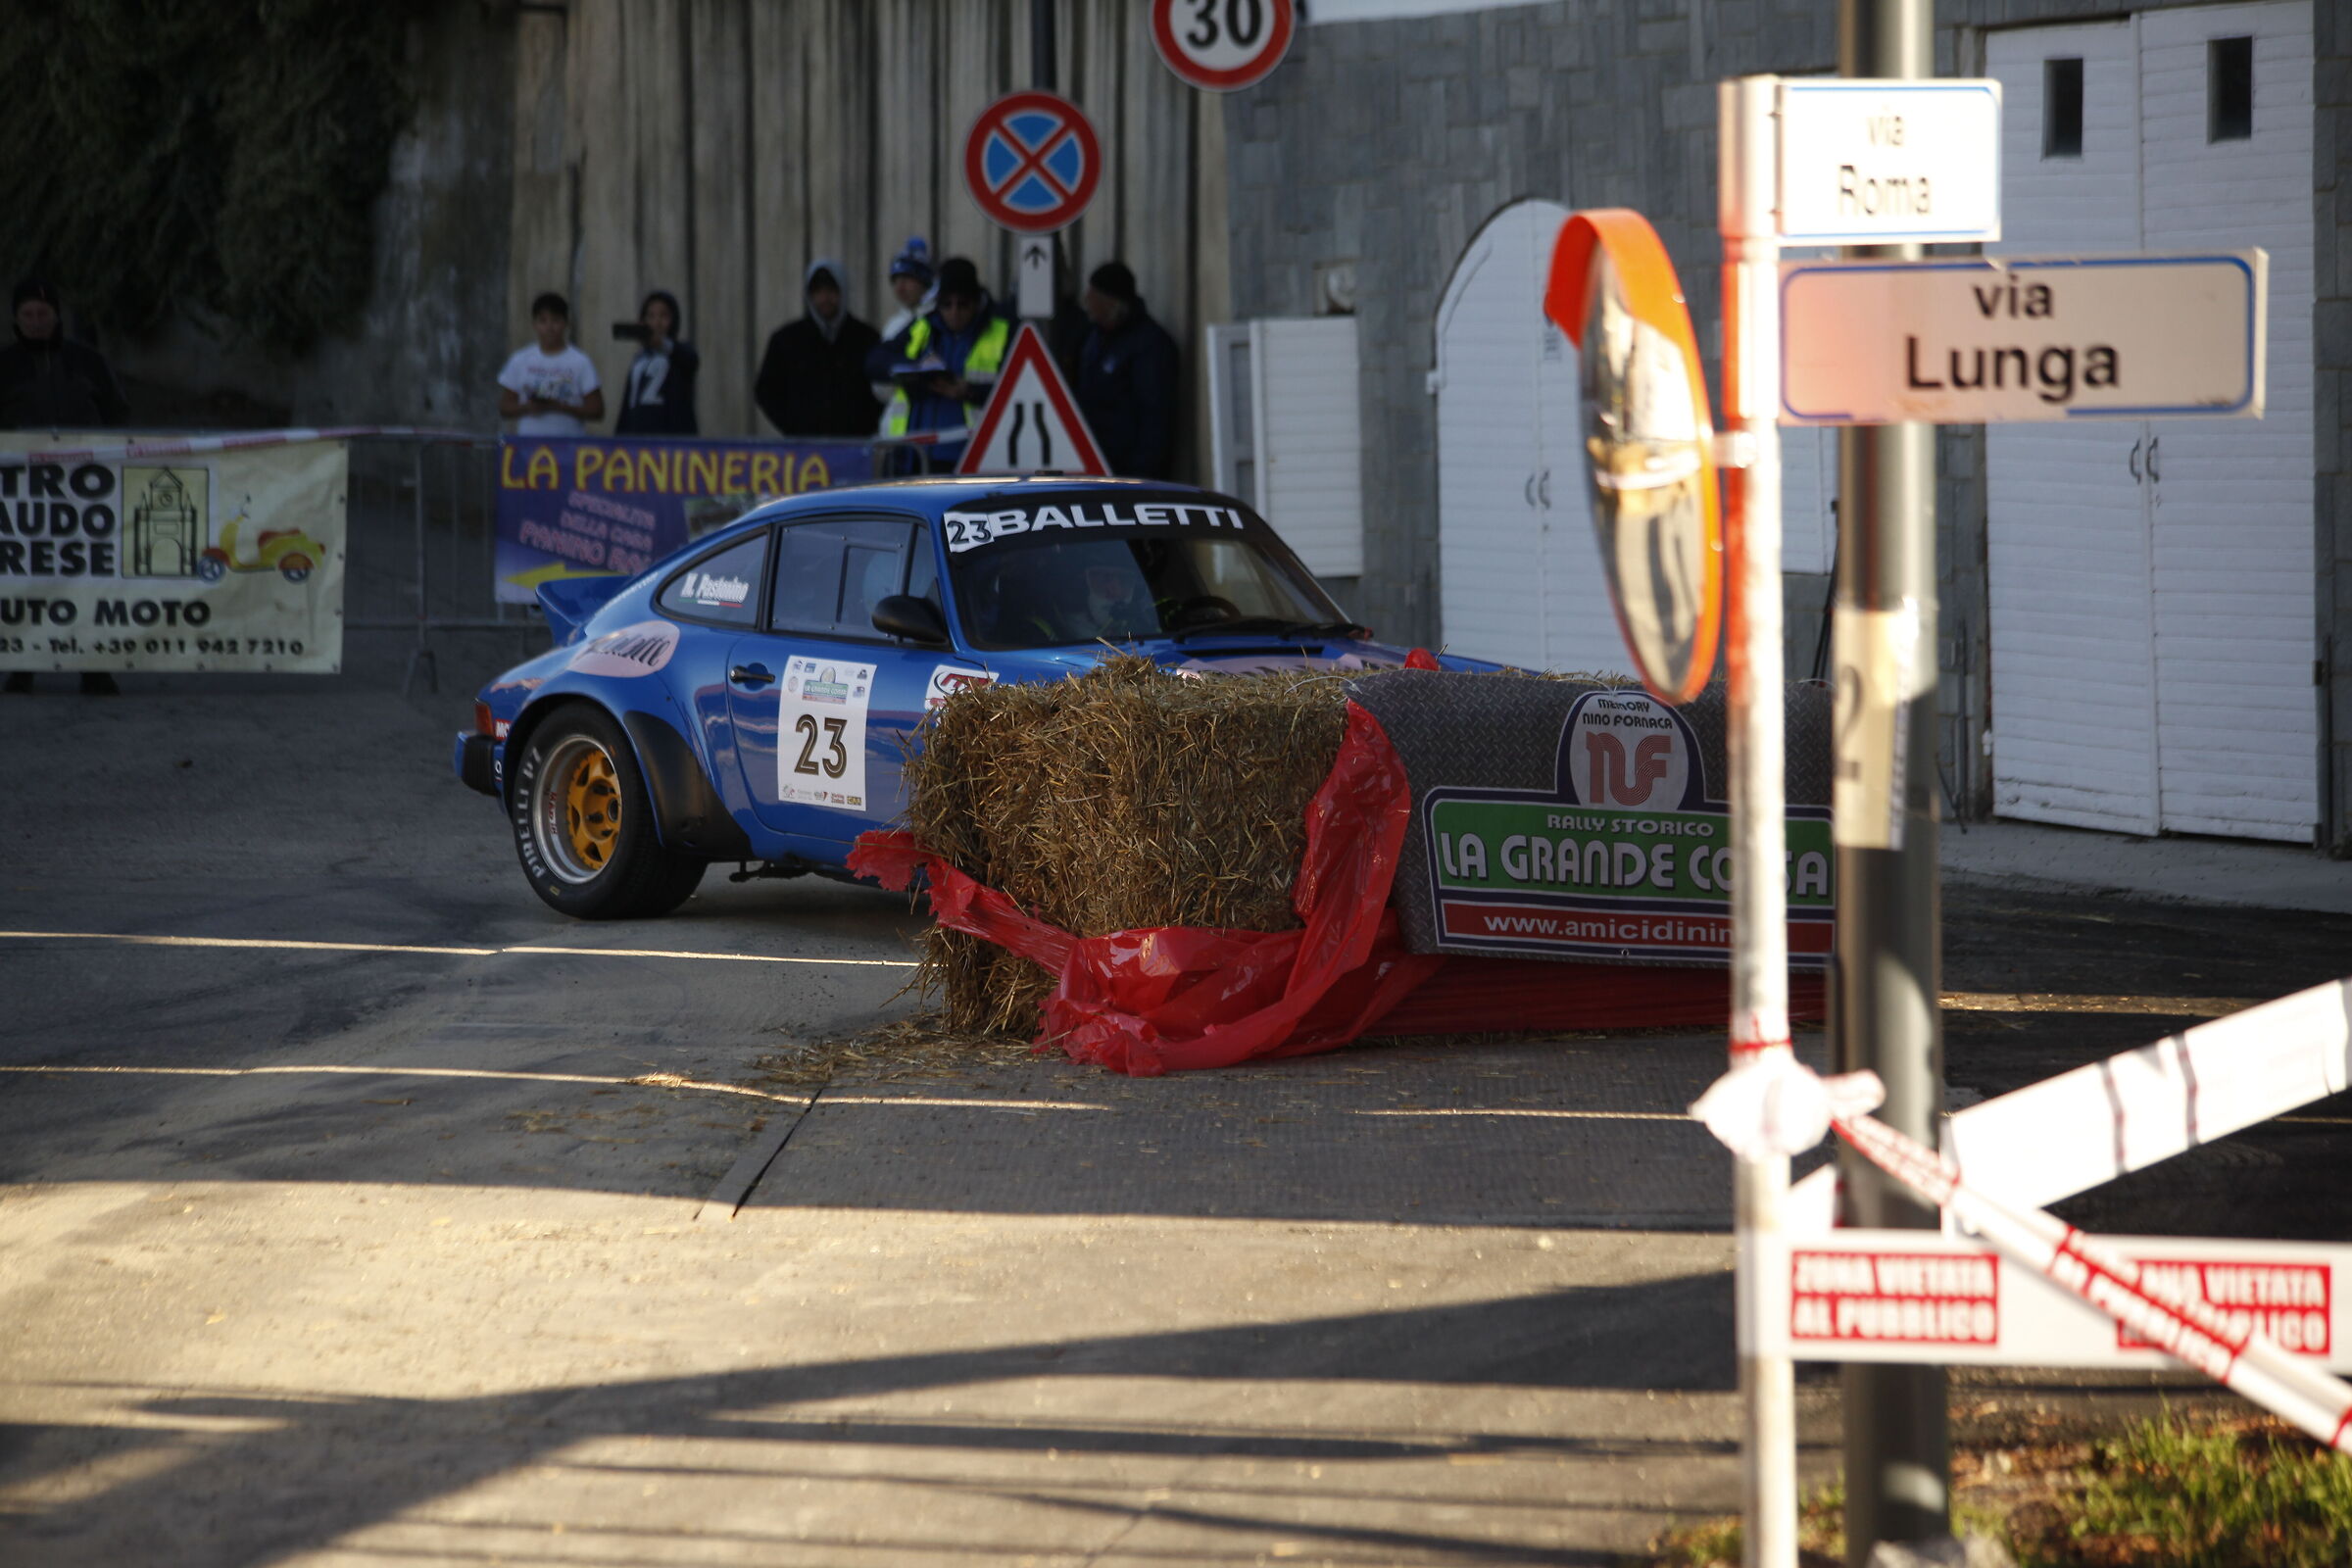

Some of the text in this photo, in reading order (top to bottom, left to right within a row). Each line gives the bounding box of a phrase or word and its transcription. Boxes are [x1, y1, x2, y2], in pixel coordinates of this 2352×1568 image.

[1186, 0, 1262, 47] 30
[1867, 105, 1906, 147] via
[1838, 165, 1931, 217] Roma
[1971, 272, 2056, 319] via
[1905, 335, 2120, 406] Lunga
[0, 464, 116, 499] TRO
[501, 444, 830, 496] LA PANINERIA
[947, 503, 1244, 544] 23 BALLETTI
[0, 541, 116, 576] RESE
[1, 599, 212, 626] UTO MOTO
[50, 639, 85, 655] Tel.
[95, 640, 137, 656] +39
[146, 639, 186, 655] 011
[198, 640, 240, 656] 942
[247, 640, 305, 657] 7210
[1583, 712, 1674, 729] NINO FORNACA
[1597, 699, 1651, 713] MEMORY
[794, 713, 848, 779] 23
[1546, 813, 1715, 838] RALLY STORICO
[1440, 831, 1828, 896] LA GRANDE COA
[1484, 914, 1733, 944] www.amicidinin
